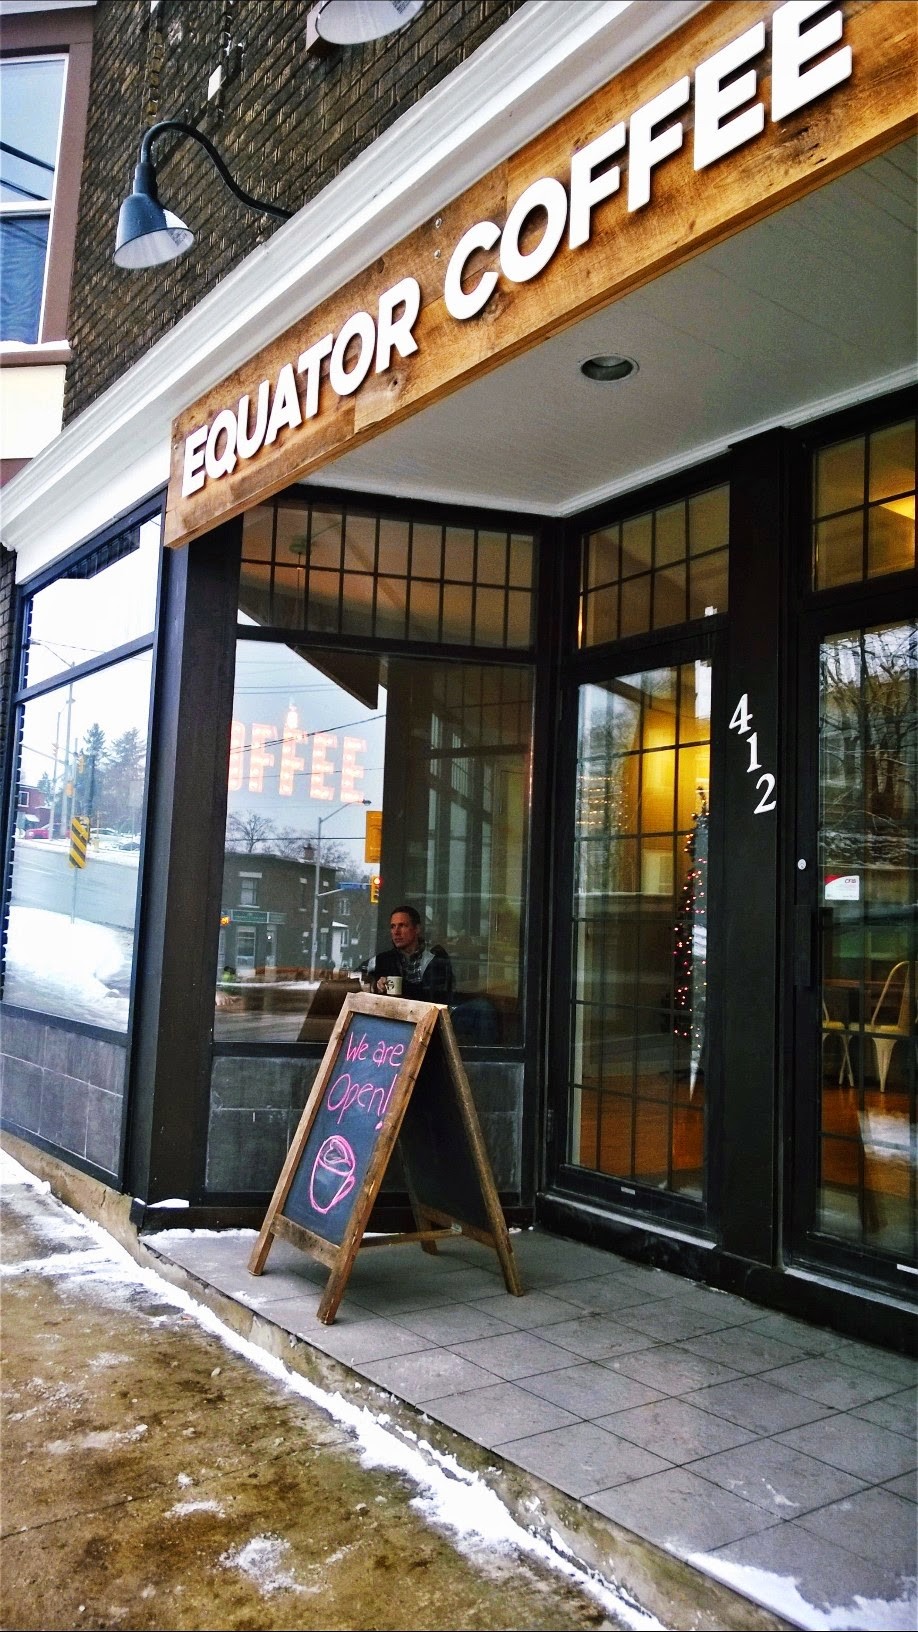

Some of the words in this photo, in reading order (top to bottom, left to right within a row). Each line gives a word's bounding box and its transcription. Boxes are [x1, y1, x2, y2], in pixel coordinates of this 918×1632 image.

[181, 276, 421, 498] EQUATOR
[443, 0, 853, 321] COFFEE
[728, 693, 777, 815] 412
[346, 1032, 369, 1063] We
[372, 1040, 404, 1067] are
[327, 1073, 398, 1131] Open!
